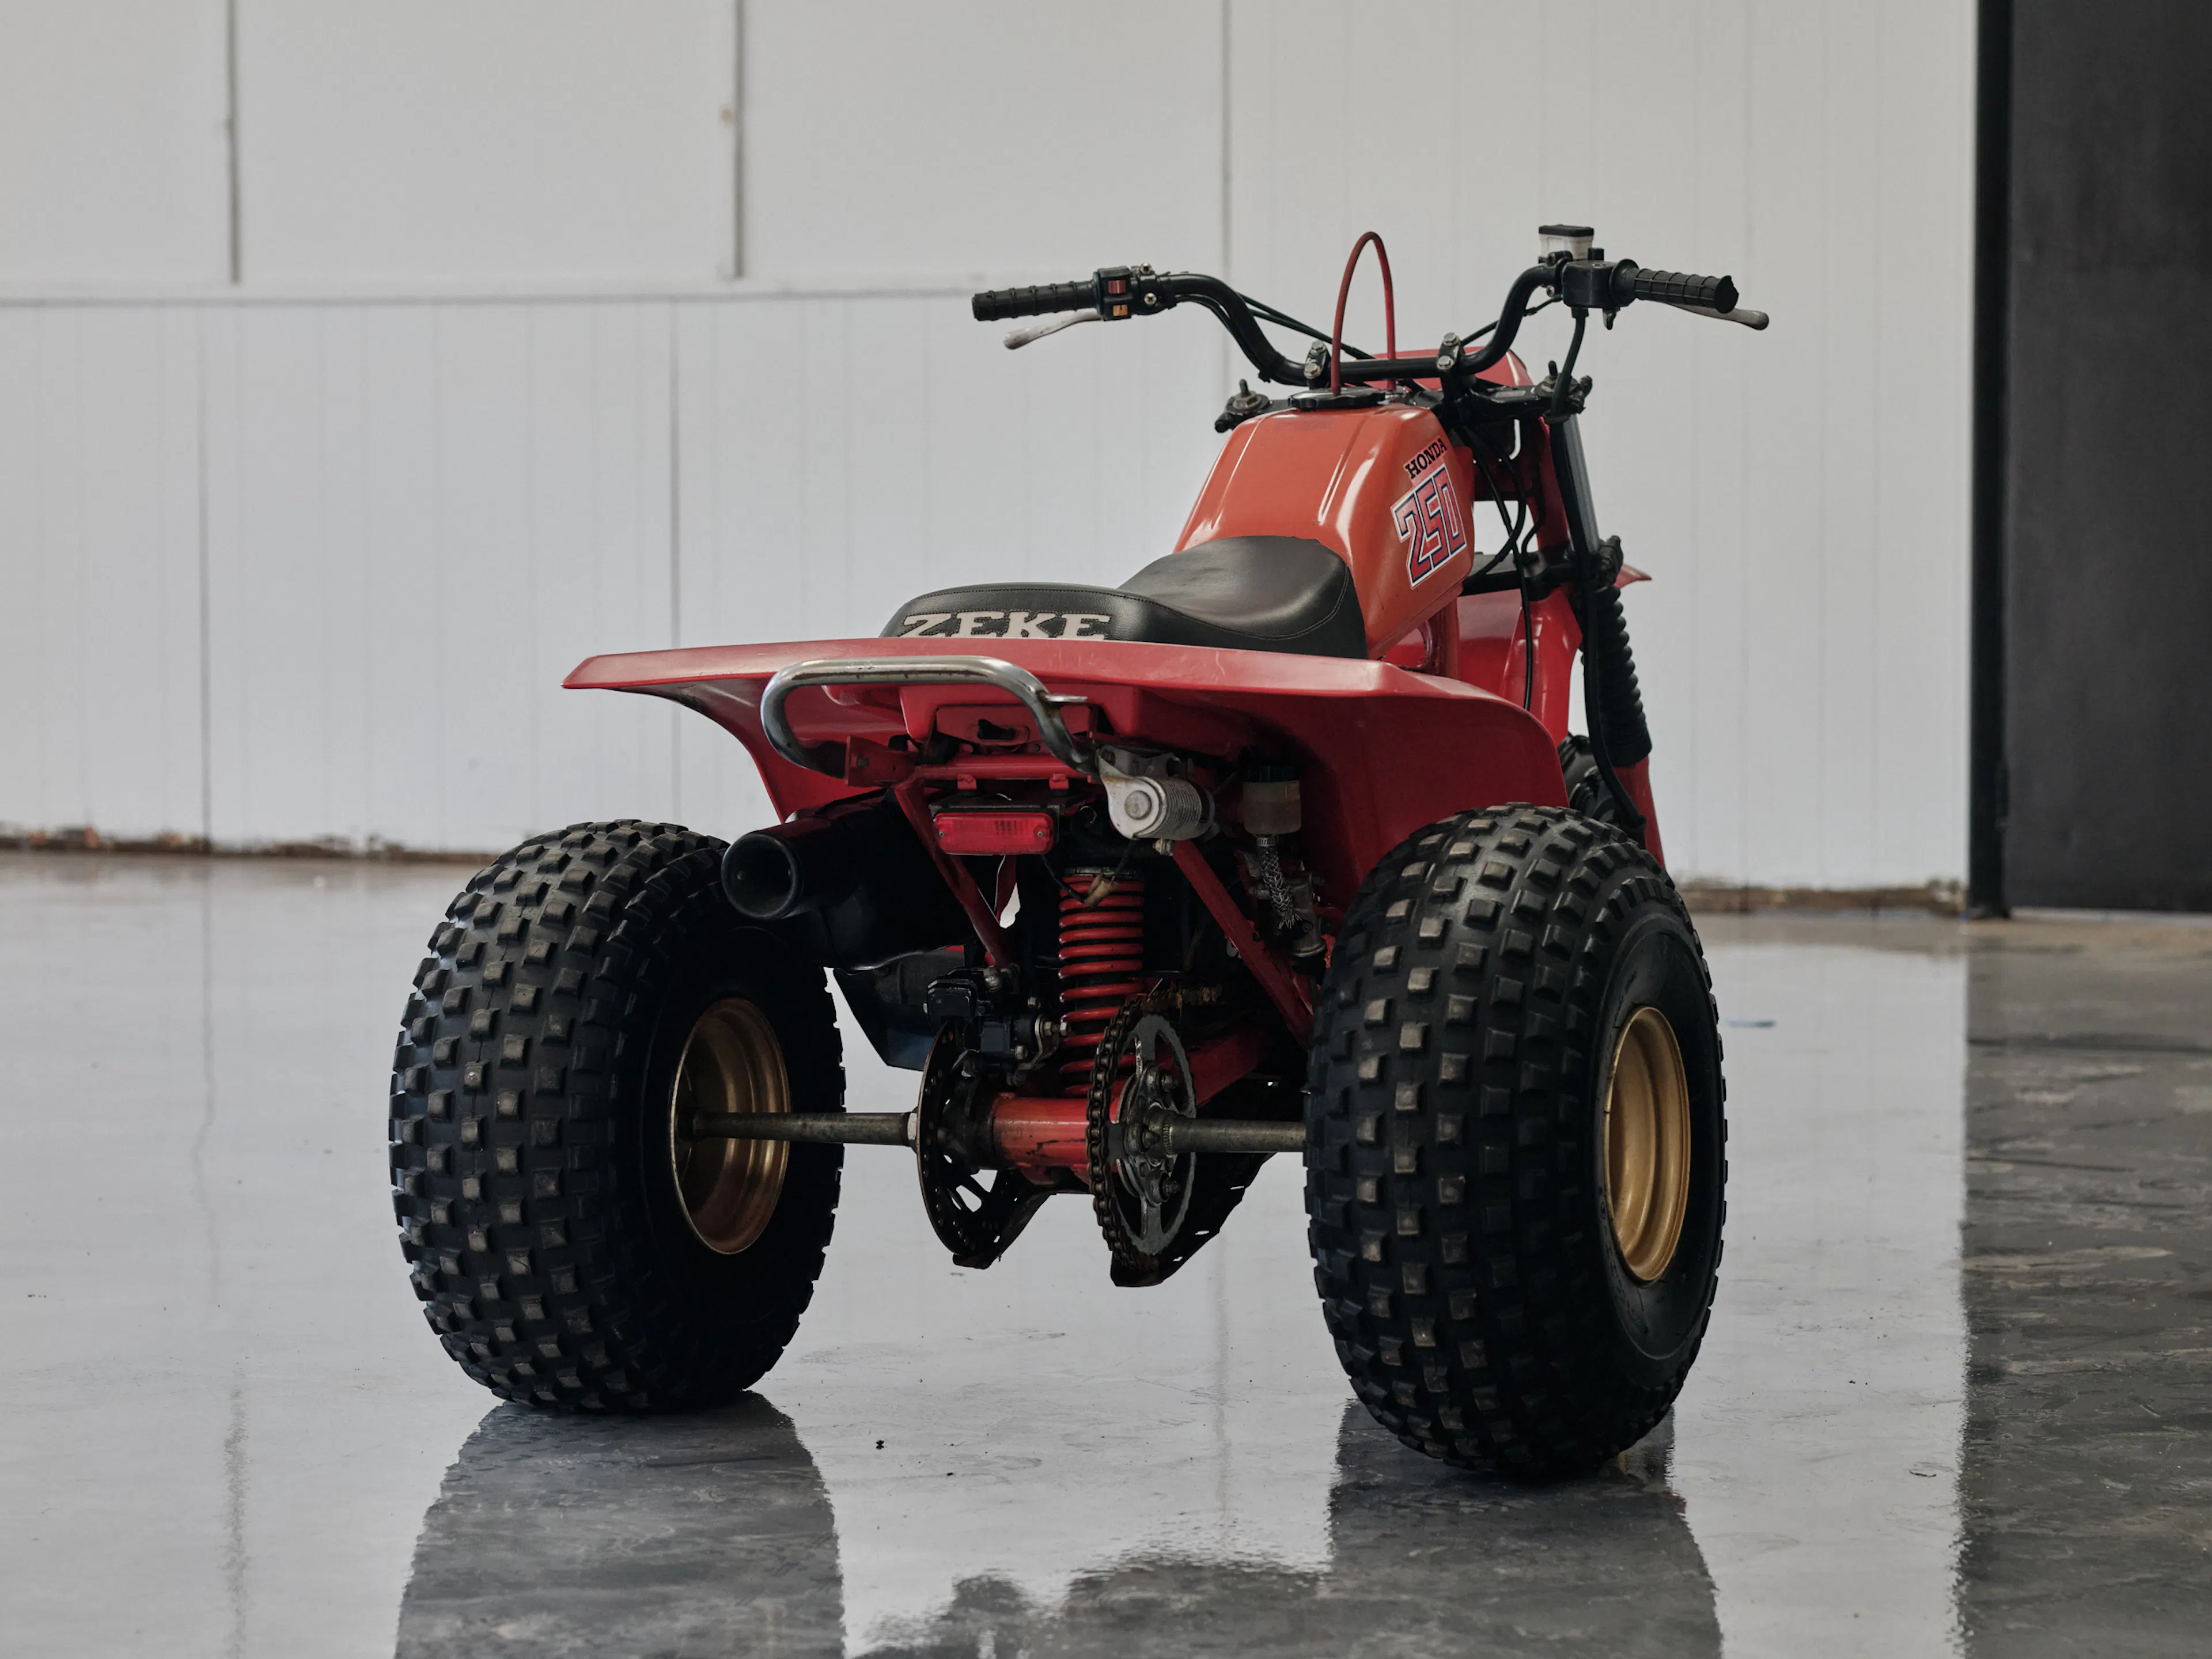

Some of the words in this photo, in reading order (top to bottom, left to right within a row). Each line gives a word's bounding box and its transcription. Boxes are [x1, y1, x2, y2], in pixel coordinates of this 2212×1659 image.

[1405, 438, 1447, 479] HONDA
[1392, 464, 1467, 587] 250
[897, 611, 1111, 639] ZEKE
